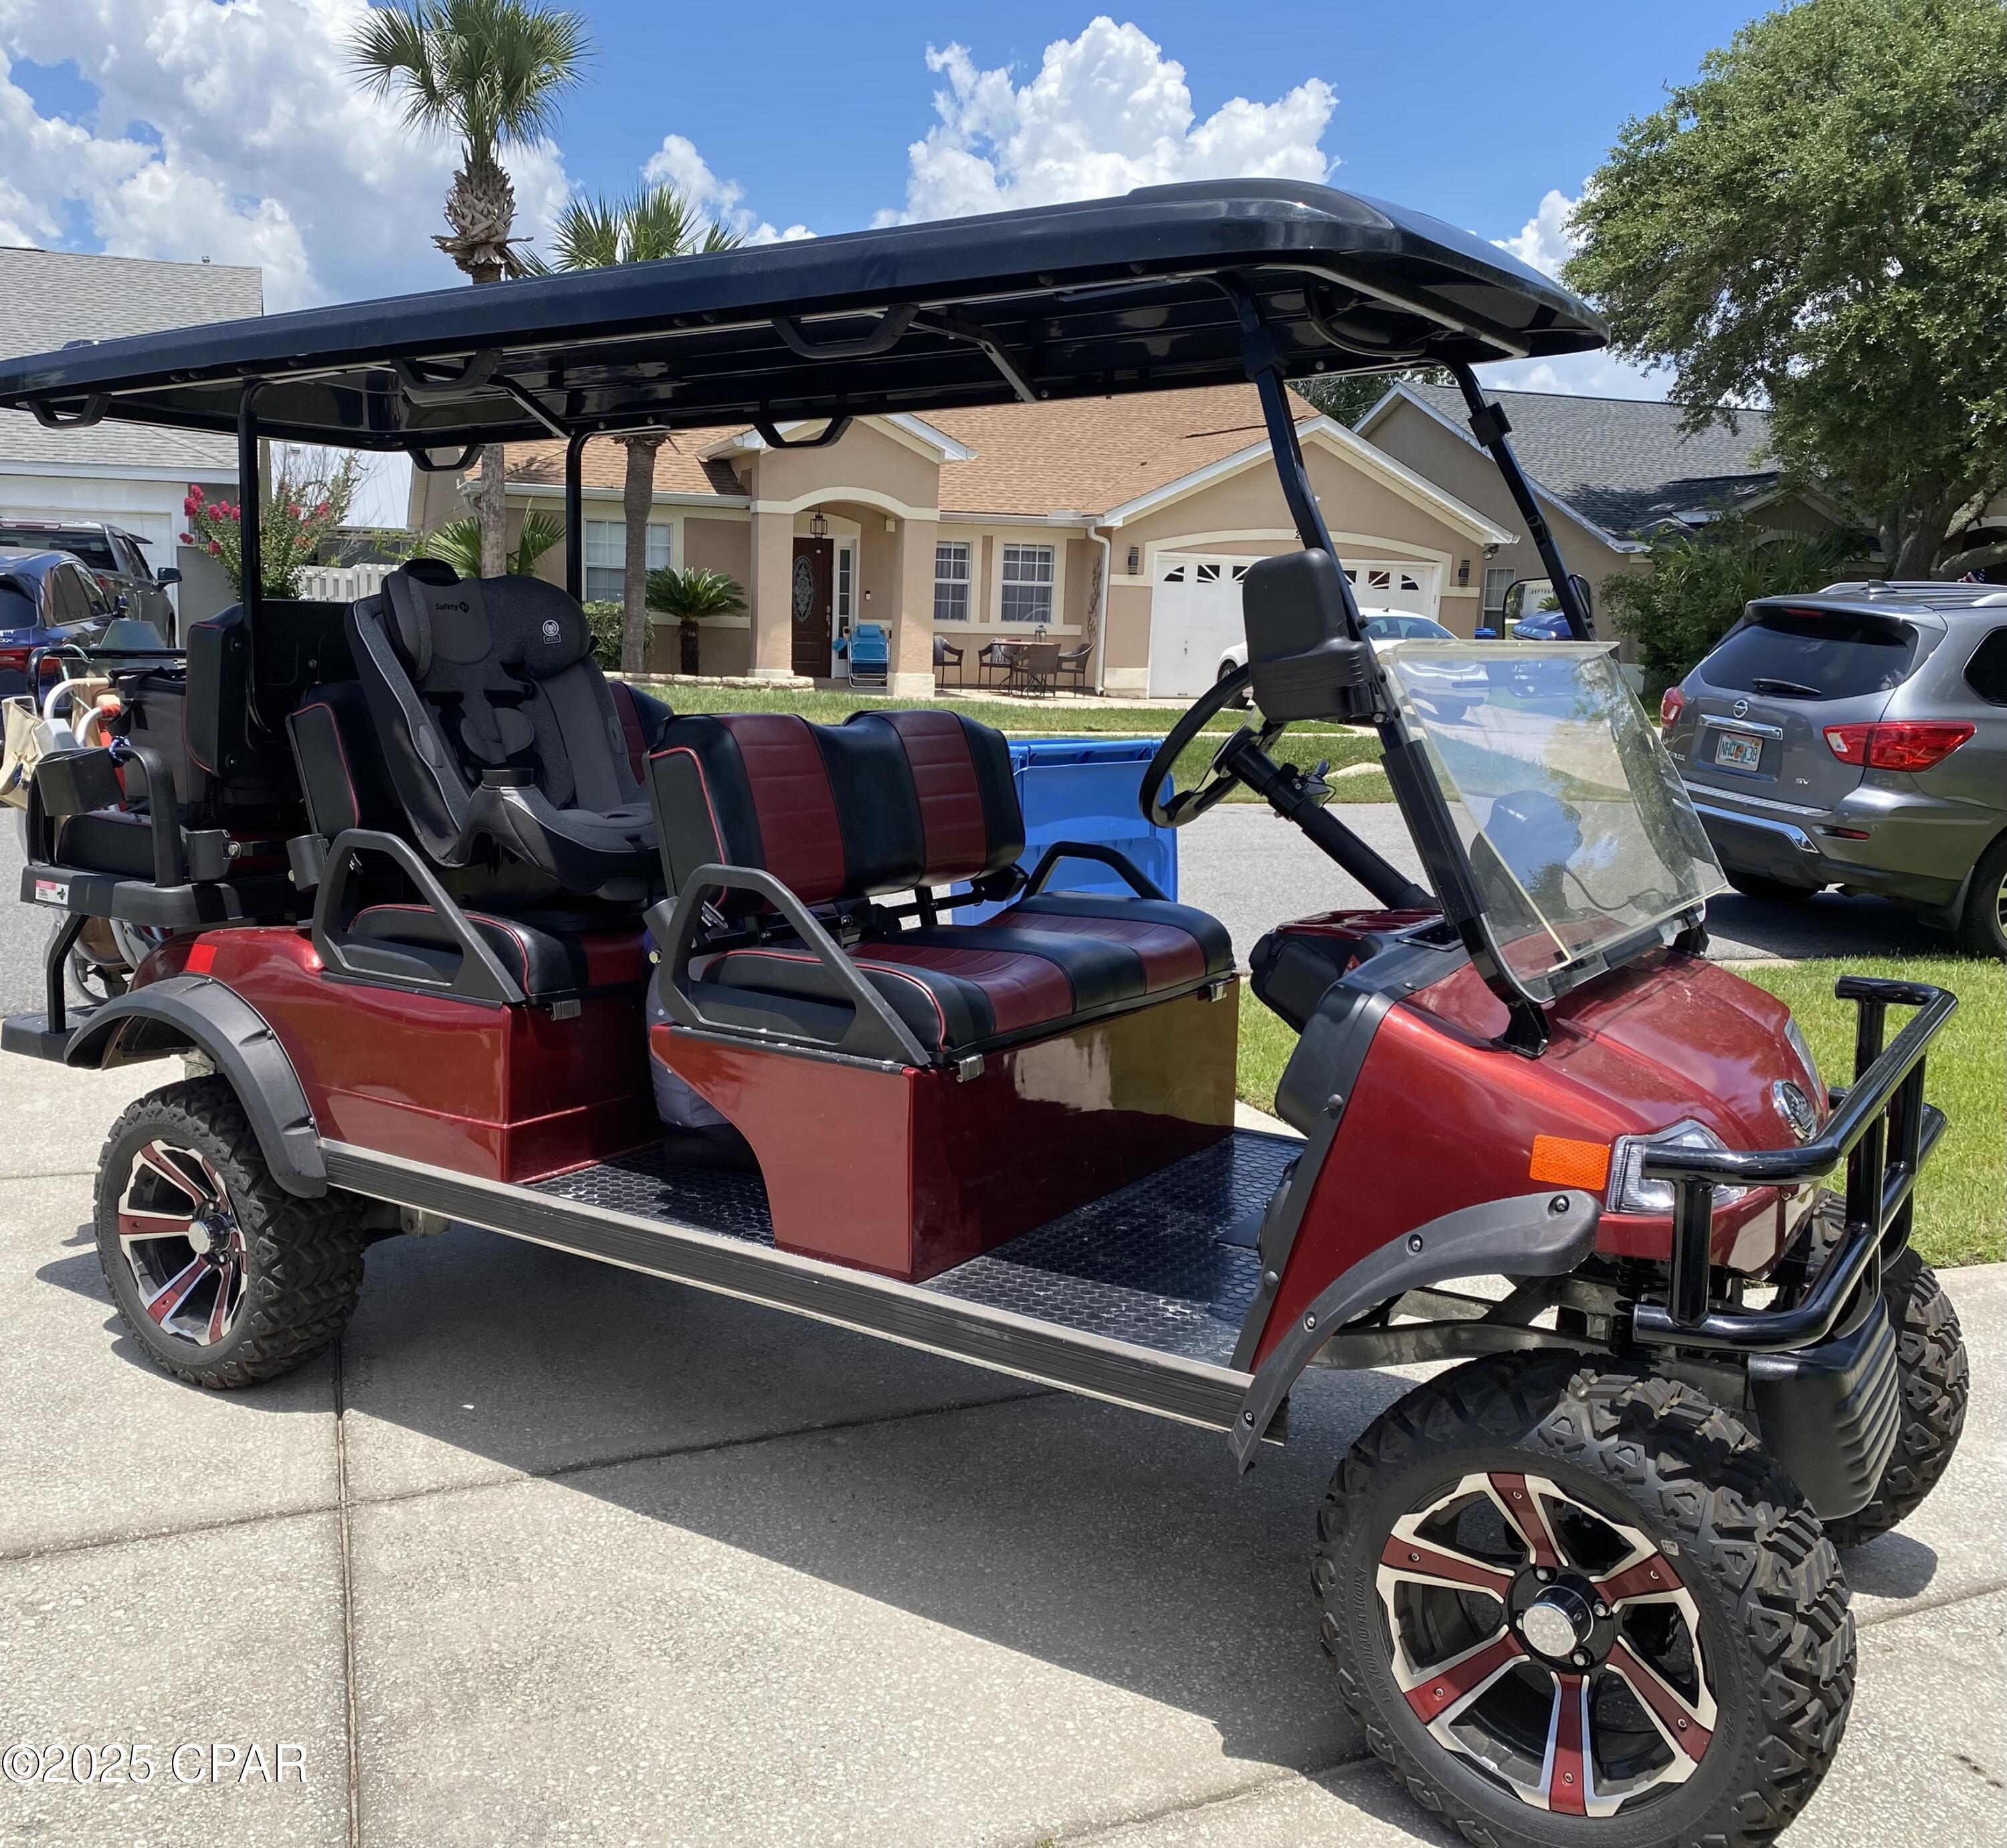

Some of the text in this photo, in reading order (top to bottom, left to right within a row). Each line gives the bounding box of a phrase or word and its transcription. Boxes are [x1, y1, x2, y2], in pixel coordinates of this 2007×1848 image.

[435, 603, 458, 611] Safety
[1795, 777, 1810, 785] SV
[1353, 1564, 1394, 1704] EVOLUTION
